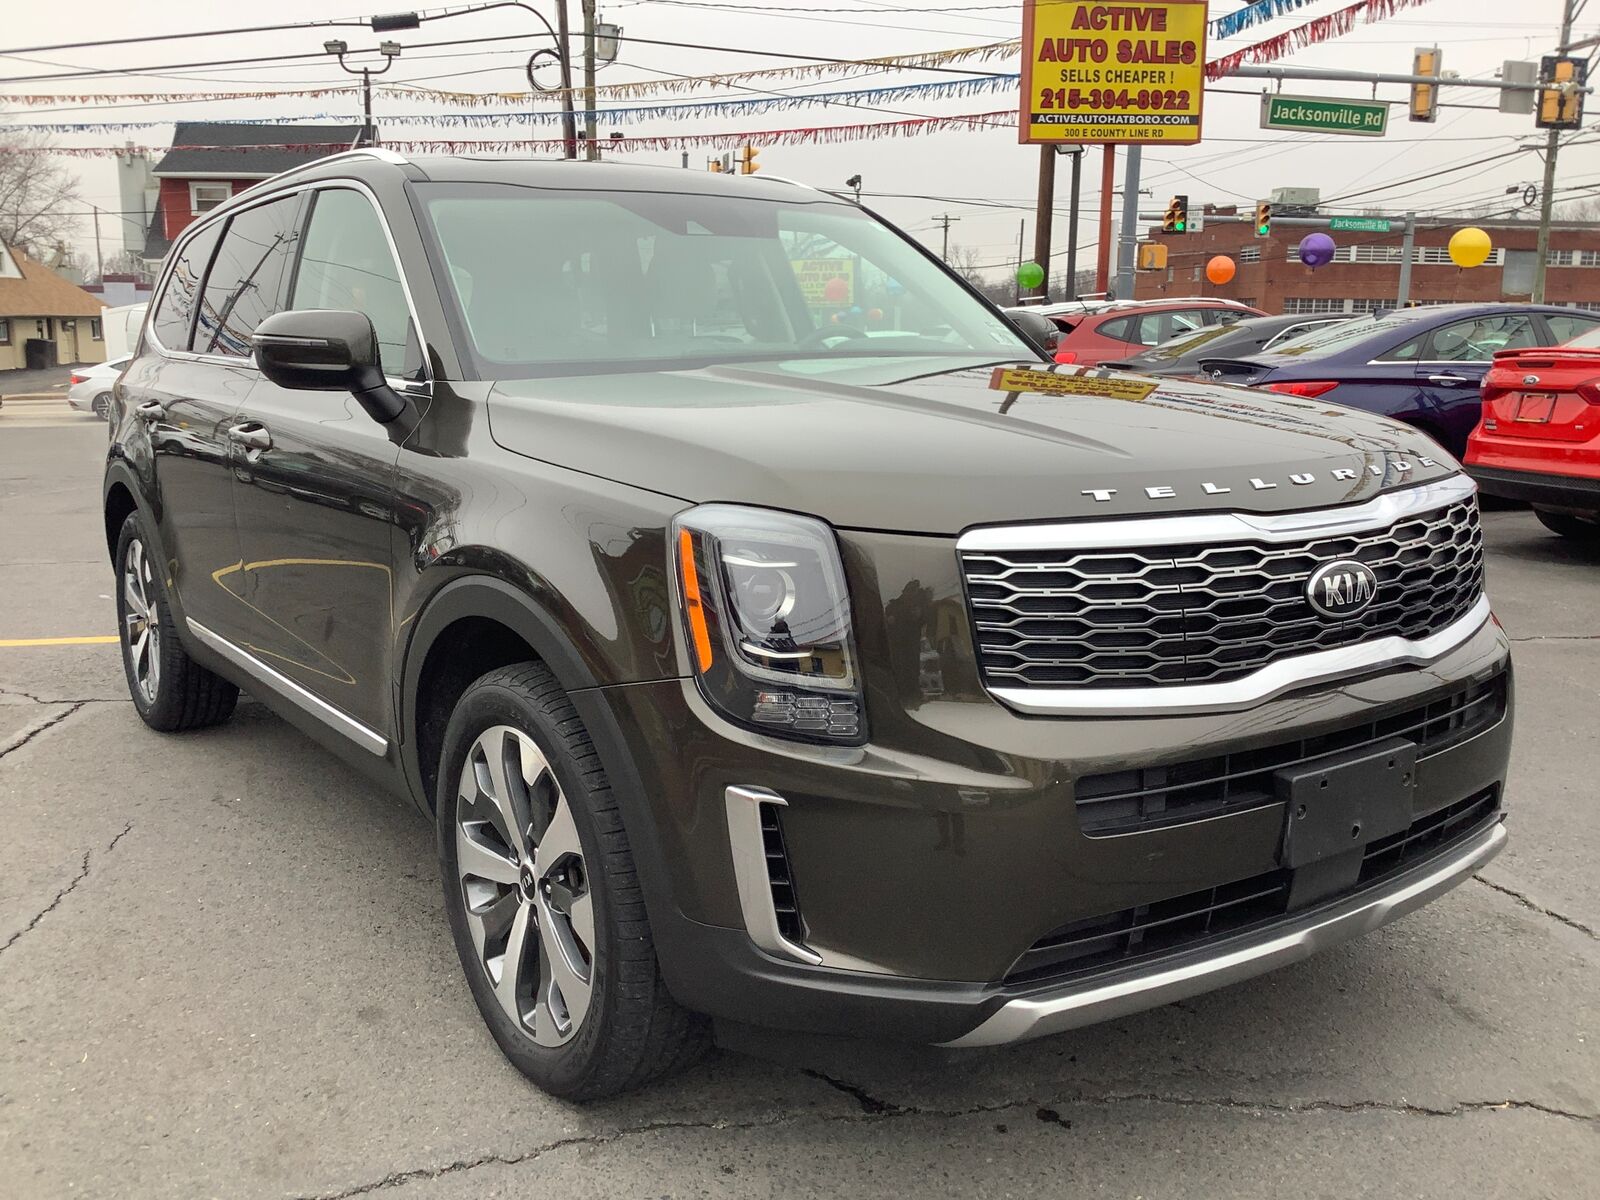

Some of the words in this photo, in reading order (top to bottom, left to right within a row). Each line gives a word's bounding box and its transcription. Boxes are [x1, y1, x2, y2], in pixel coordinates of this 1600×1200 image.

[1071, 6, 1168, 32] ACTIVE
[1038, 38, 1109, 63] AUTO
[1116, 39, 1196, 65] SALES
[1060, 69, 1101, 83] SELLS
[1105, 69, 1166, 84] CHEAPER
[1040, 87, 1190, 110] 215-394-8922
[1037, 114, 1190, 125] ACTIVEAUTOHATBORO.COM
[1273, 105, 1361, 125] Jacksonville
[1364, 111, 1383, 126] Rd
[1064, 128, 1080, 138] 300
[1082, 128, 1088, 138] E
[1090, 128, 1127, 138] COUNTY
[1129, 128, 1149, 138] LINE
[1152, 129, 1164, 138] RD
[1081, 455, 1435, 502] TELLURIDE
[1322, 571, 1371, 607] KIA
